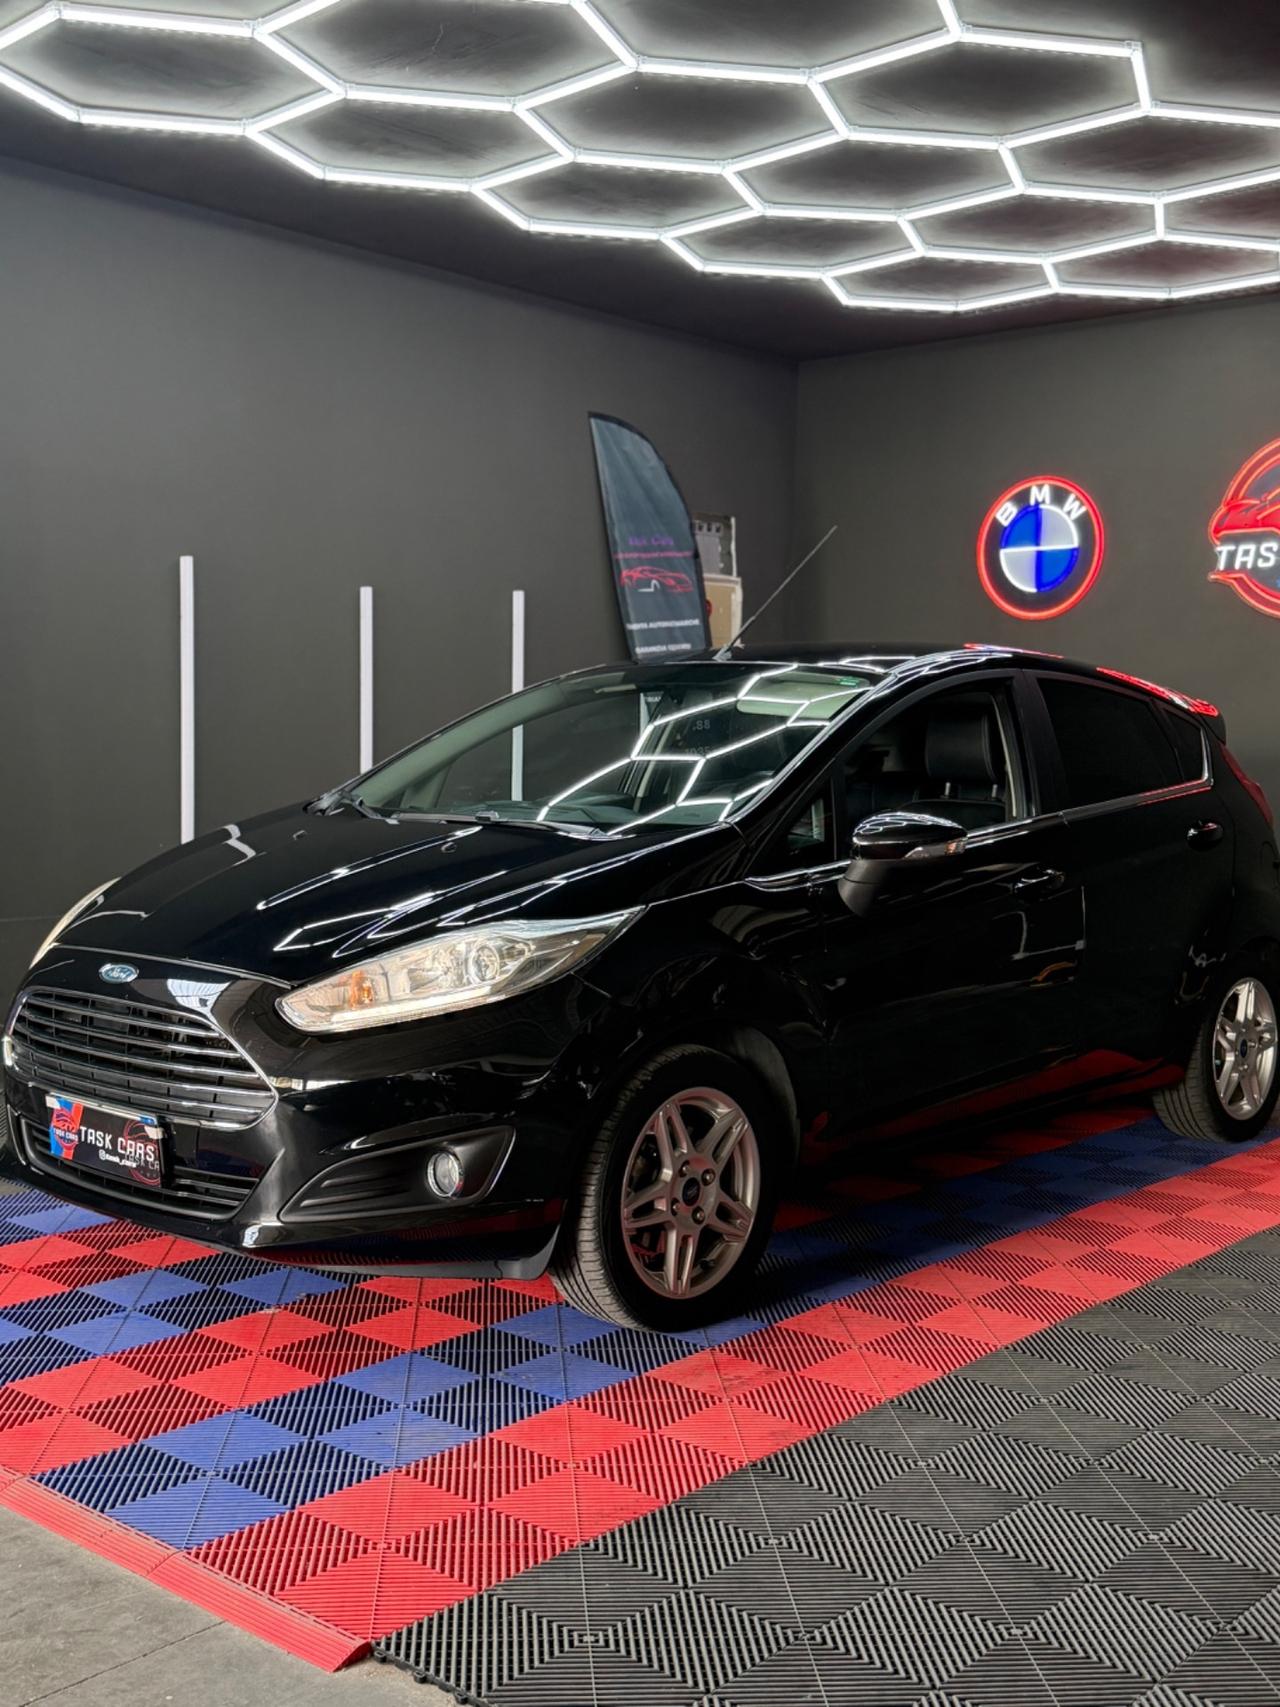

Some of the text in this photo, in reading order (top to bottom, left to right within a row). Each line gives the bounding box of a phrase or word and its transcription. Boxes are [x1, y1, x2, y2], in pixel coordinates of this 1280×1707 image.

[995, 484, 1087, 527] BMW
[80, 1126, 155, 1162] TASK CARS
